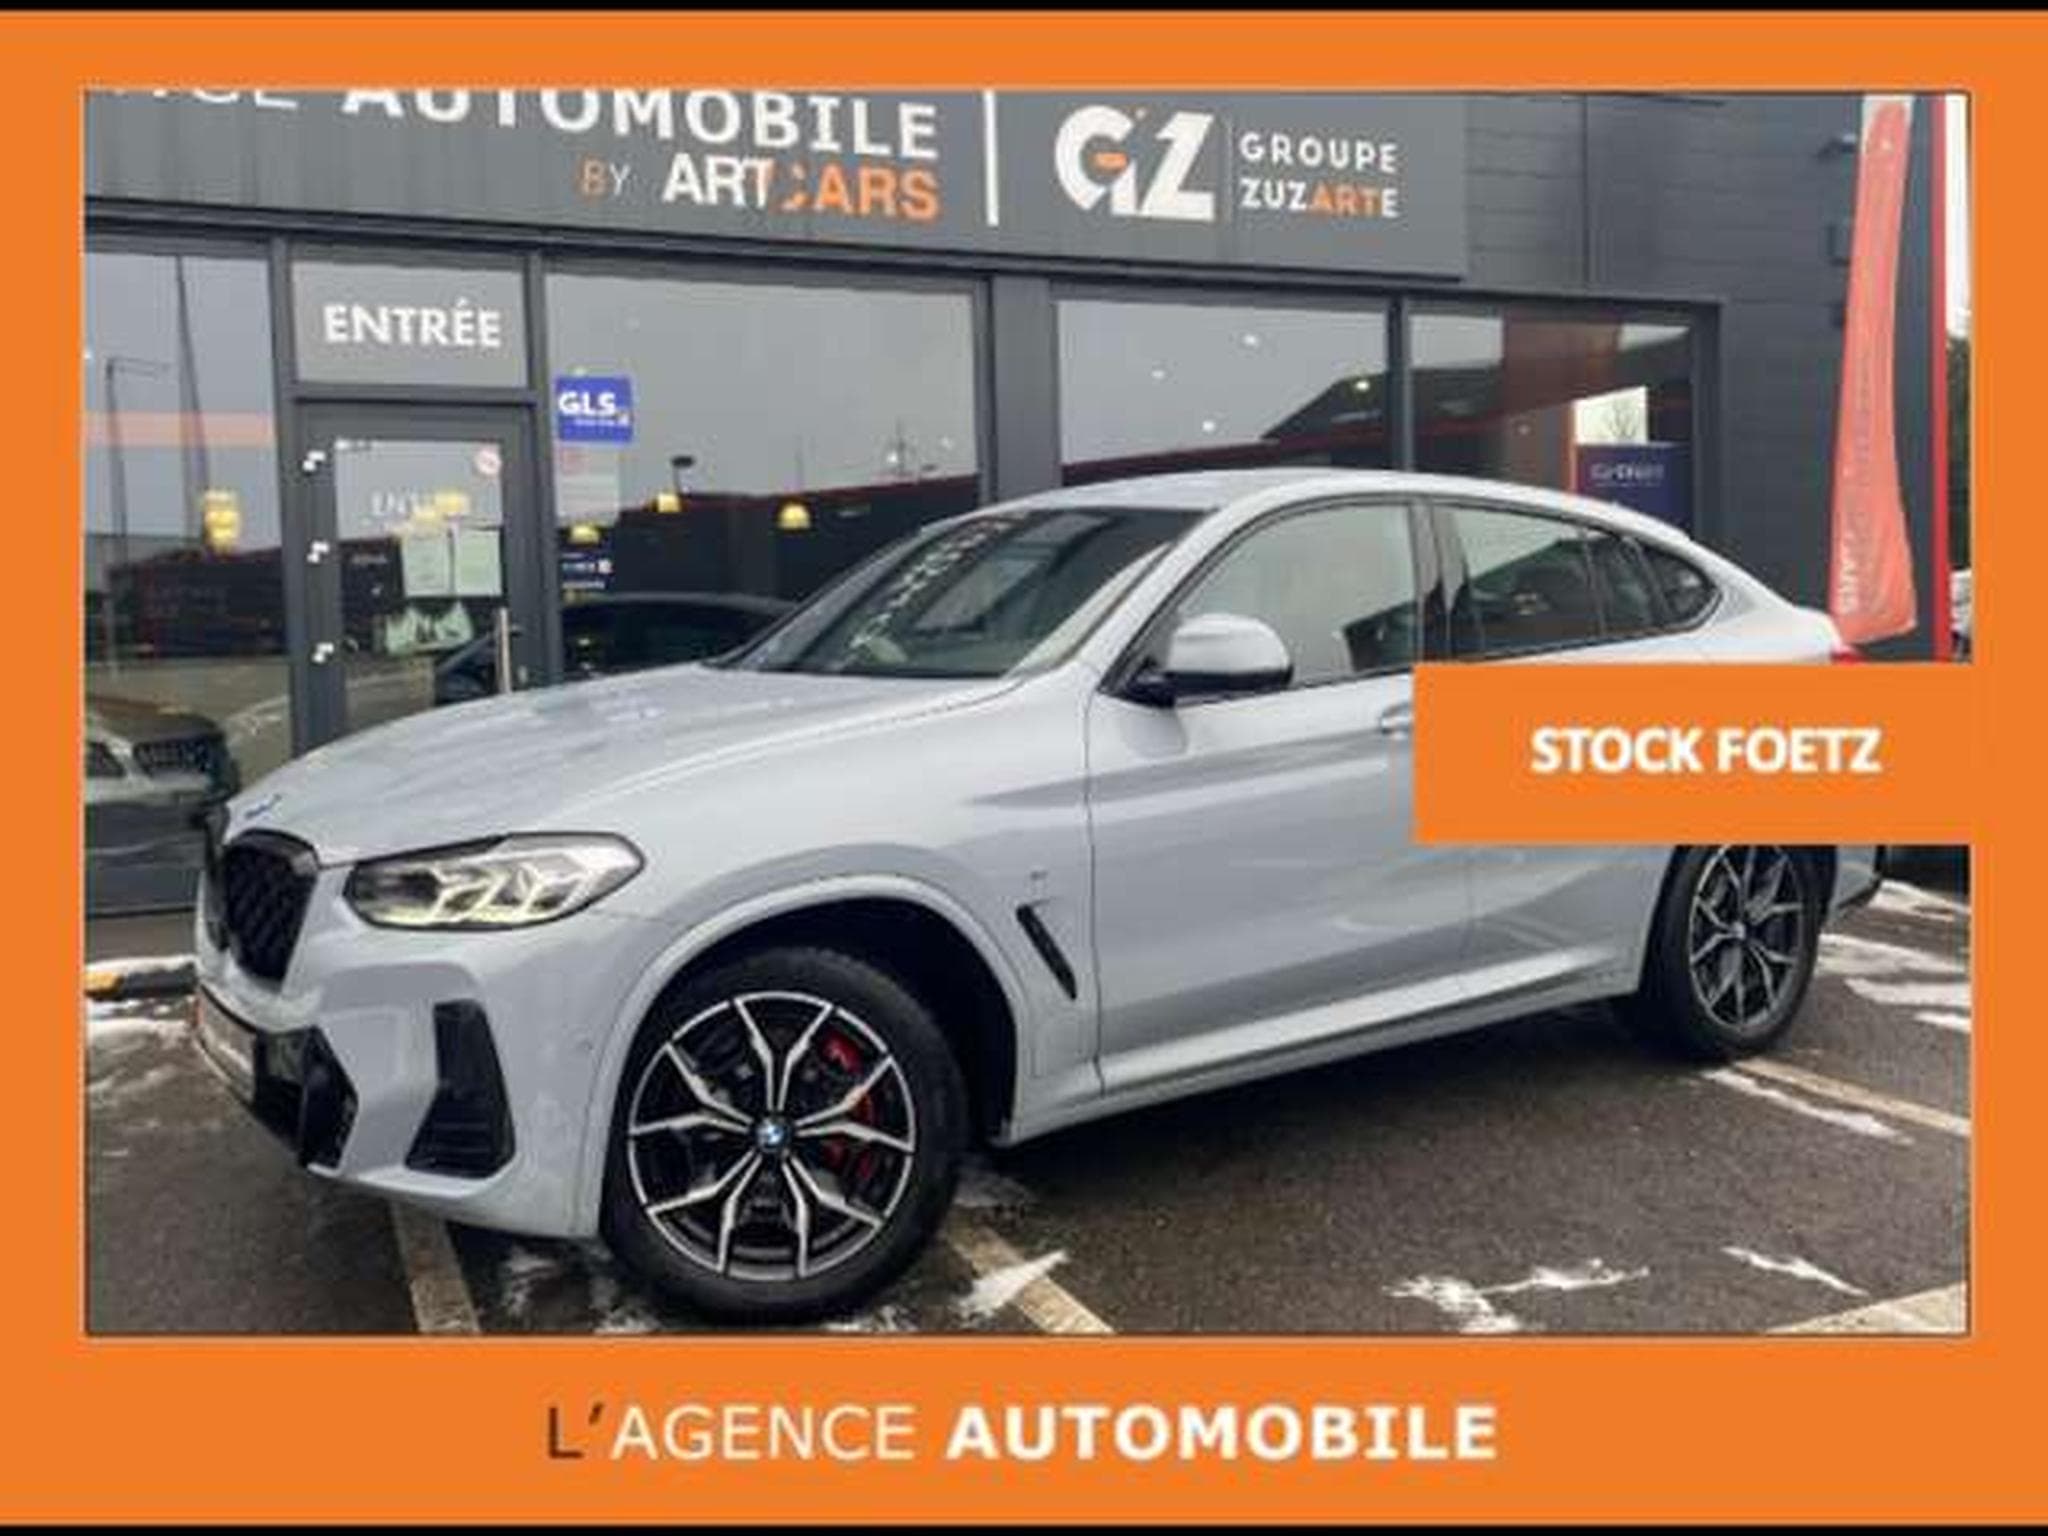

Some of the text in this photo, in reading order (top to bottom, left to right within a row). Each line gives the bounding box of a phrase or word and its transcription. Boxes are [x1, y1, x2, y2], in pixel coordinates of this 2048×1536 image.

[1239, 132, 1399, 172] GROUPE
[582, 157, 631, 197] BY
[1239, 177, 1399, 217] ZUZARTE
[322, 299, 502, 347] ENTRÉE
[559, 391, 616, 416] GLS
